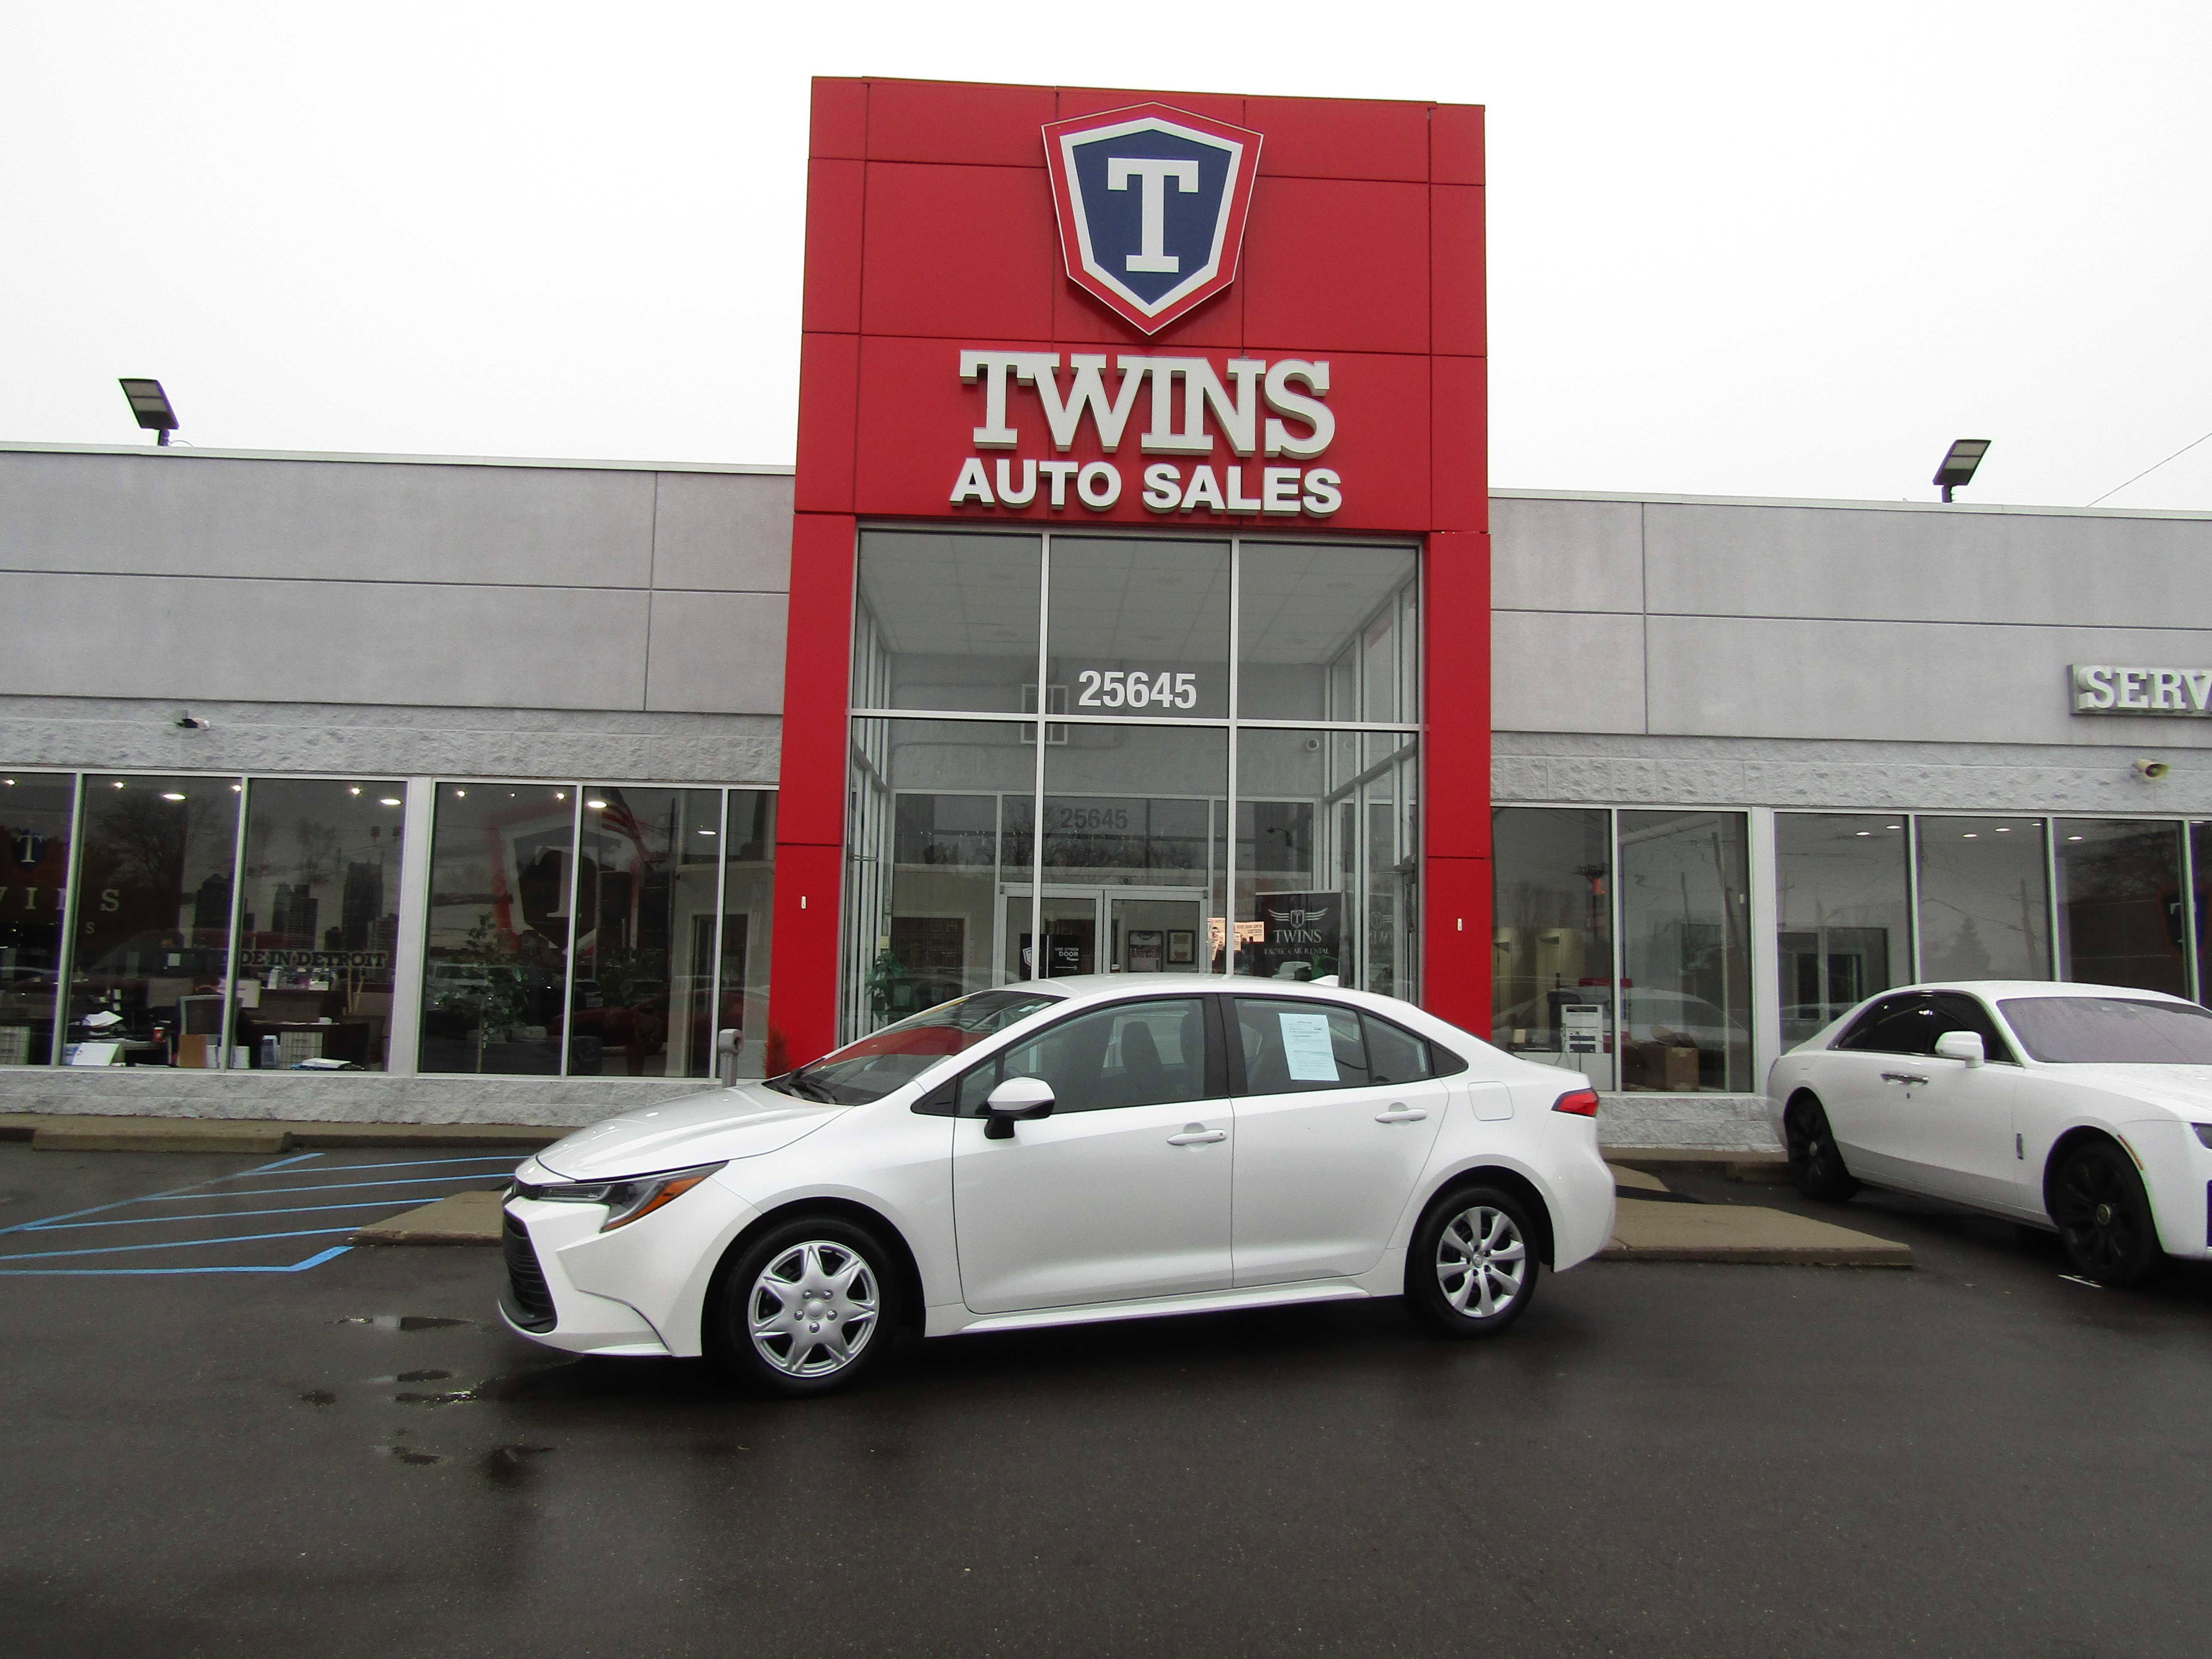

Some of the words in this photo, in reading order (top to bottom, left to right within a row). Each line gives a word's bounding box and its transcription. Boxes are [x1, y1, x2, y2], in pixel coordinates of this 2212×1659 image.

[1108, 157, 1199, 273] T
[960, 349, 1336, 460] TWINS
[949, 457, 1123, 511] AUTO
[1142, 463, 1343, 518] SALES
[1078, 670, 1197, 709] 25645
[2078, 665, 2212, 710] SERV
[1060, 808, 1128, 829] 25645
[16, 835, 43, 863] T
[1273, 929, 1322, 943] TWINS
